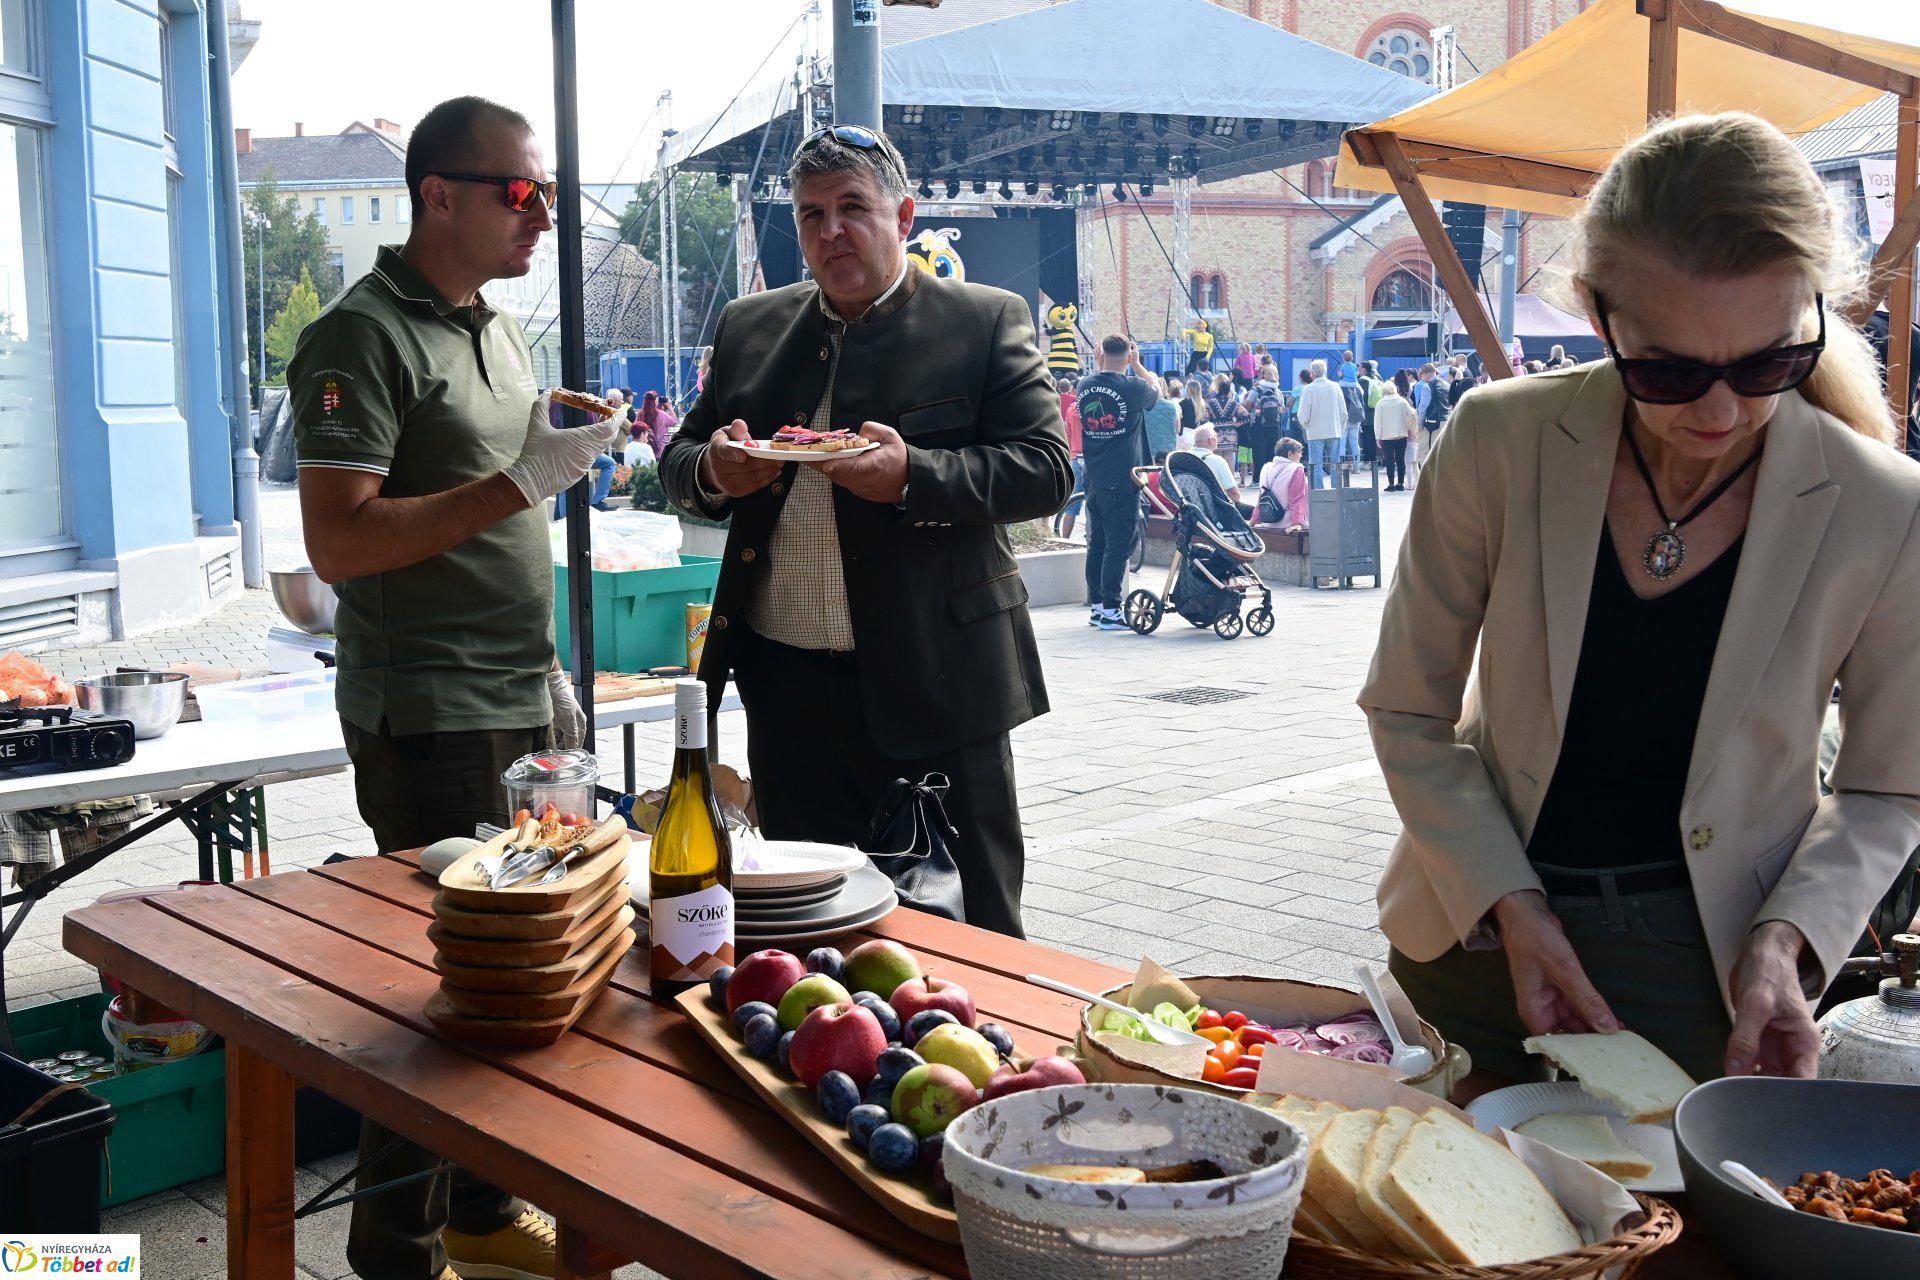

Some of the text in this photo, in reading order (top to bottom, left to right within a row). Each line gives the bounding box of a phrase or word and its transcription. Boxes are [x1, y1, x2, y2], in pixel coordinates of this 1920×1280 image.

[1090, 386, 1127, 422] CHERRY JUICE
[1100, 428, 1126, 436] PARADISE
[689, 618, 710, 640] TOPJO
